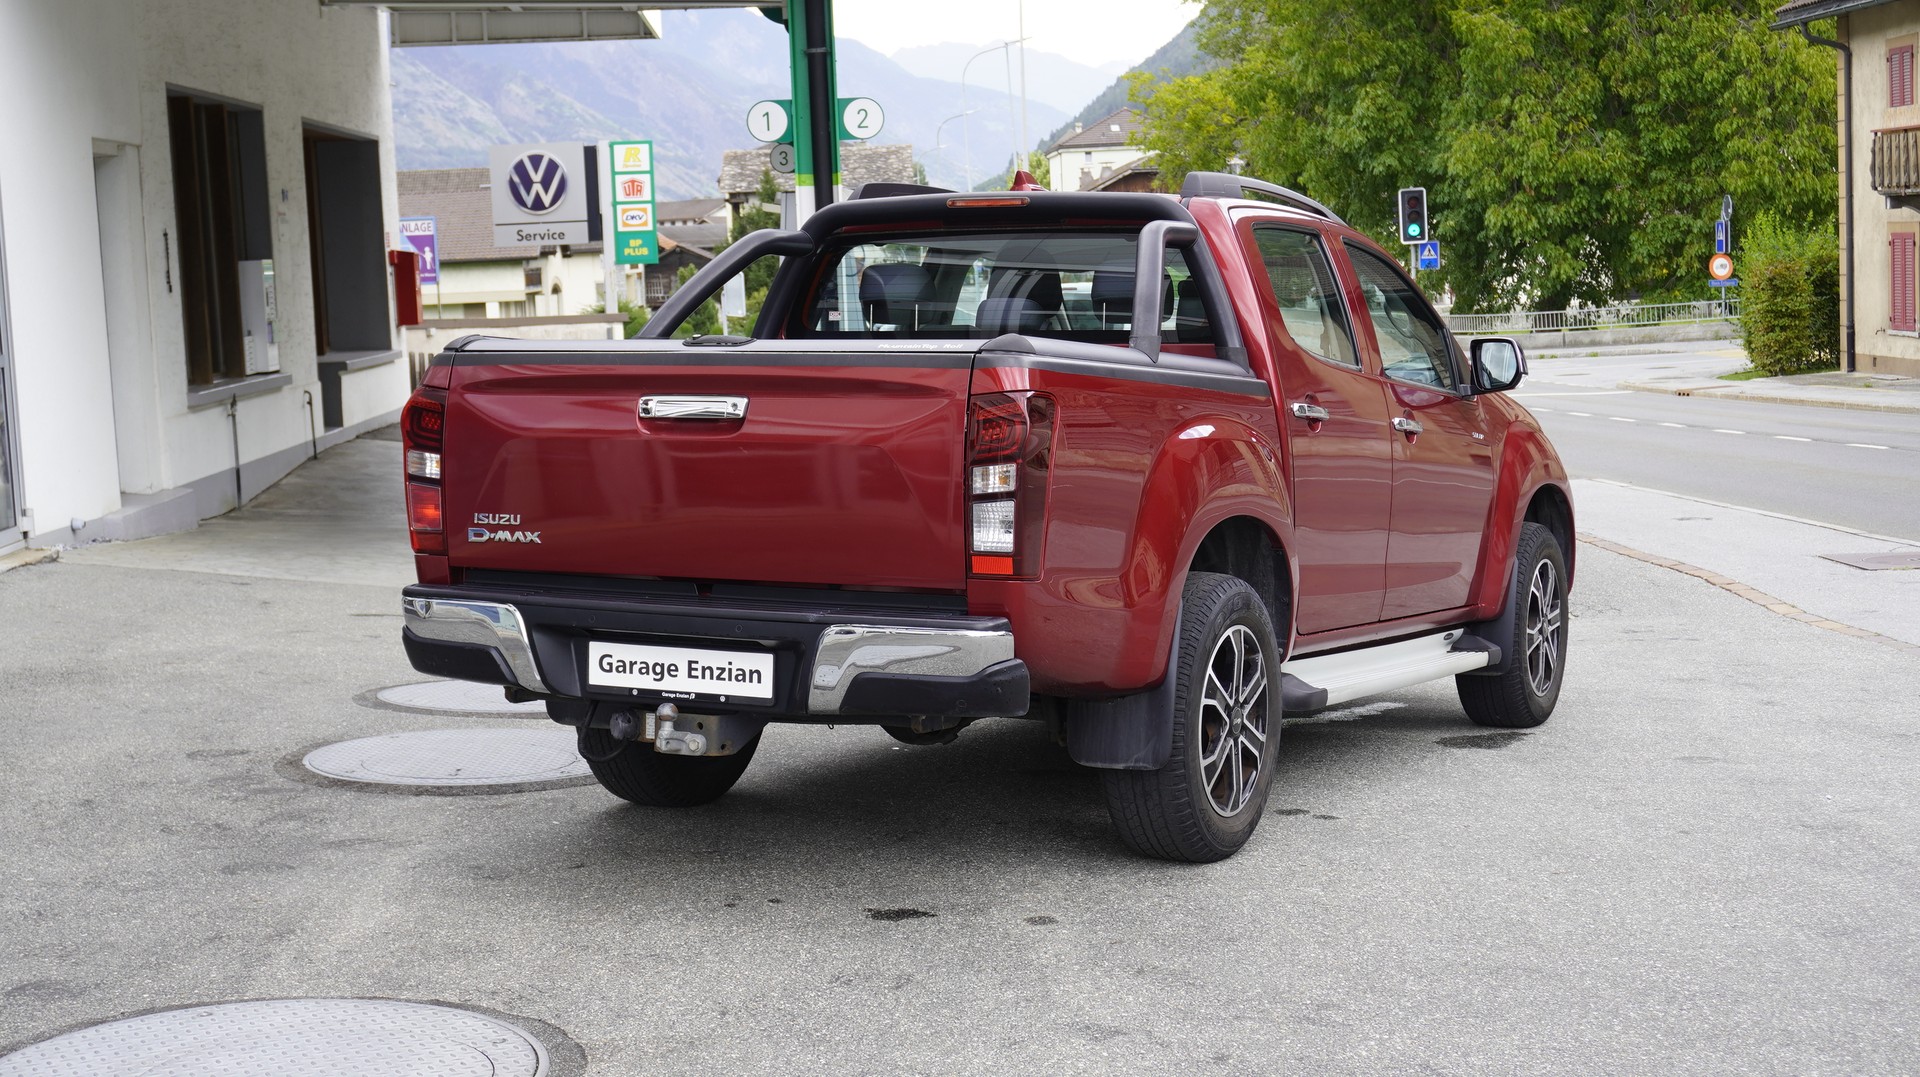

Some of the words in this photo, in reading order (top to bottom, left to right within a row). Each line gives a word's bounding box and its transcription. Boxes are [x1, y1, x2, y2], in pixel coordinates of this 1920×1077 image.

[761, 111, 771, 132] 1
[856, 108, 869, 129] 2
[778, 150, 789, 166] 3
[508, 150, 566, 213] VW
[623, 179, 643, 197] UTA
[516, 228, 566, 242] Service
[629, 239, 642, 247] BP
[624, 247, 648, 256] PLUS
[473, 512, 521, 525] ISUZU
[468, 527, 542, 544] D-MAX
[598, 653, 679, 682] Garage
[687, 660, 762, 685] Enzian
